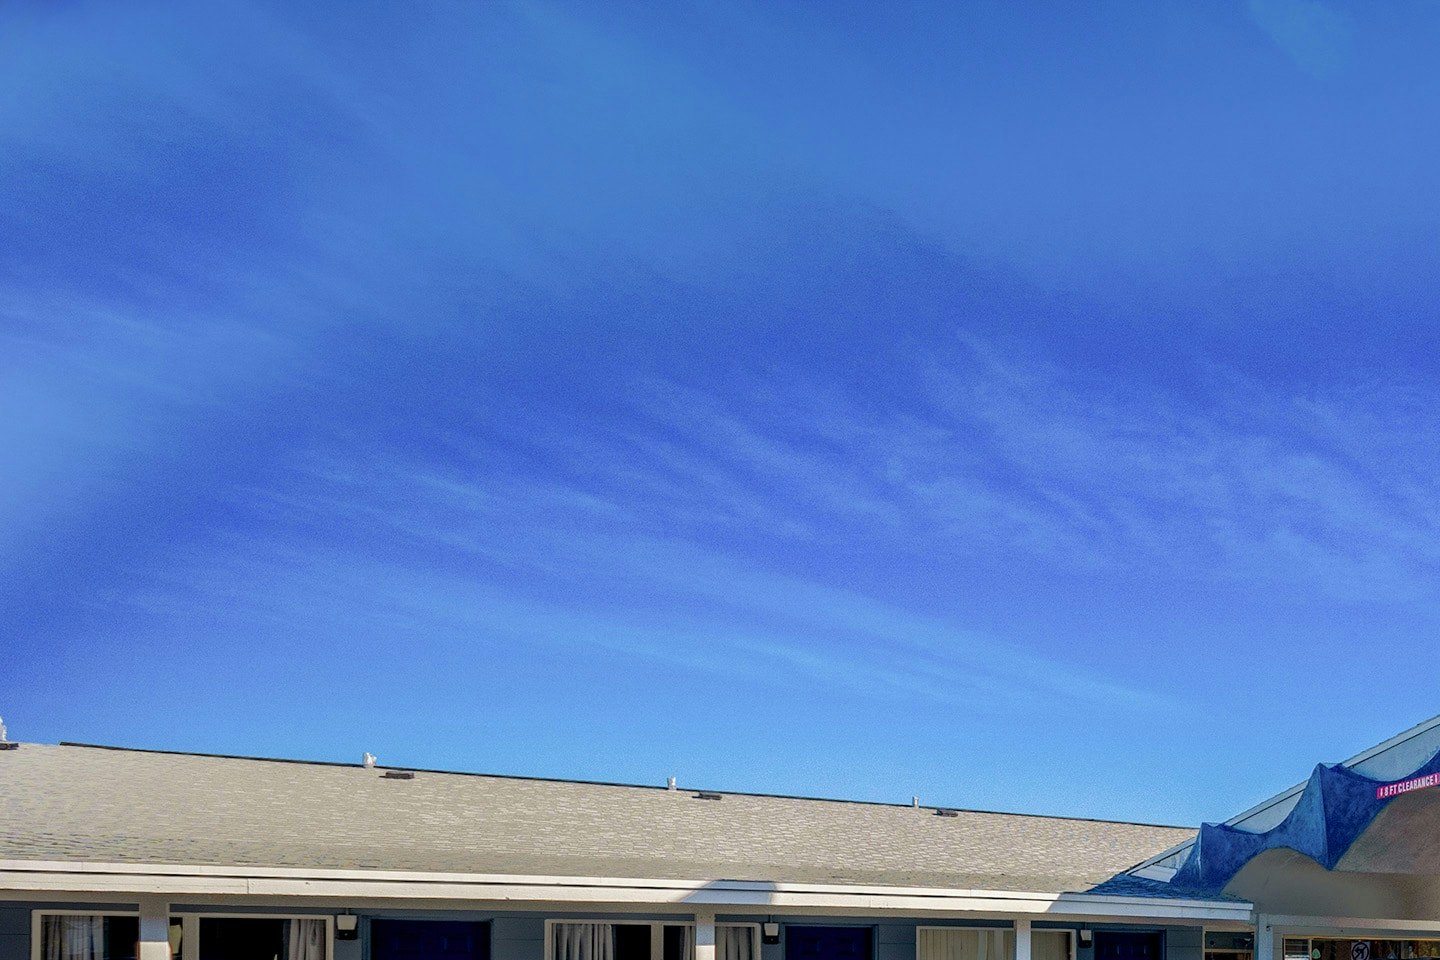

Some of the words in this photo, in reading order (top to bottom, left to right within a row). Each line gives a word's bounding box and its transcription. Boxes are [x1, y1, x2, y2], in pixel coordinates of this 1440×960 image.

[1384, 786, 1389, 797] 8
[1389, 784, 1398, 795] FT
[1398, 775, 1433, 793] CLEARANCE
